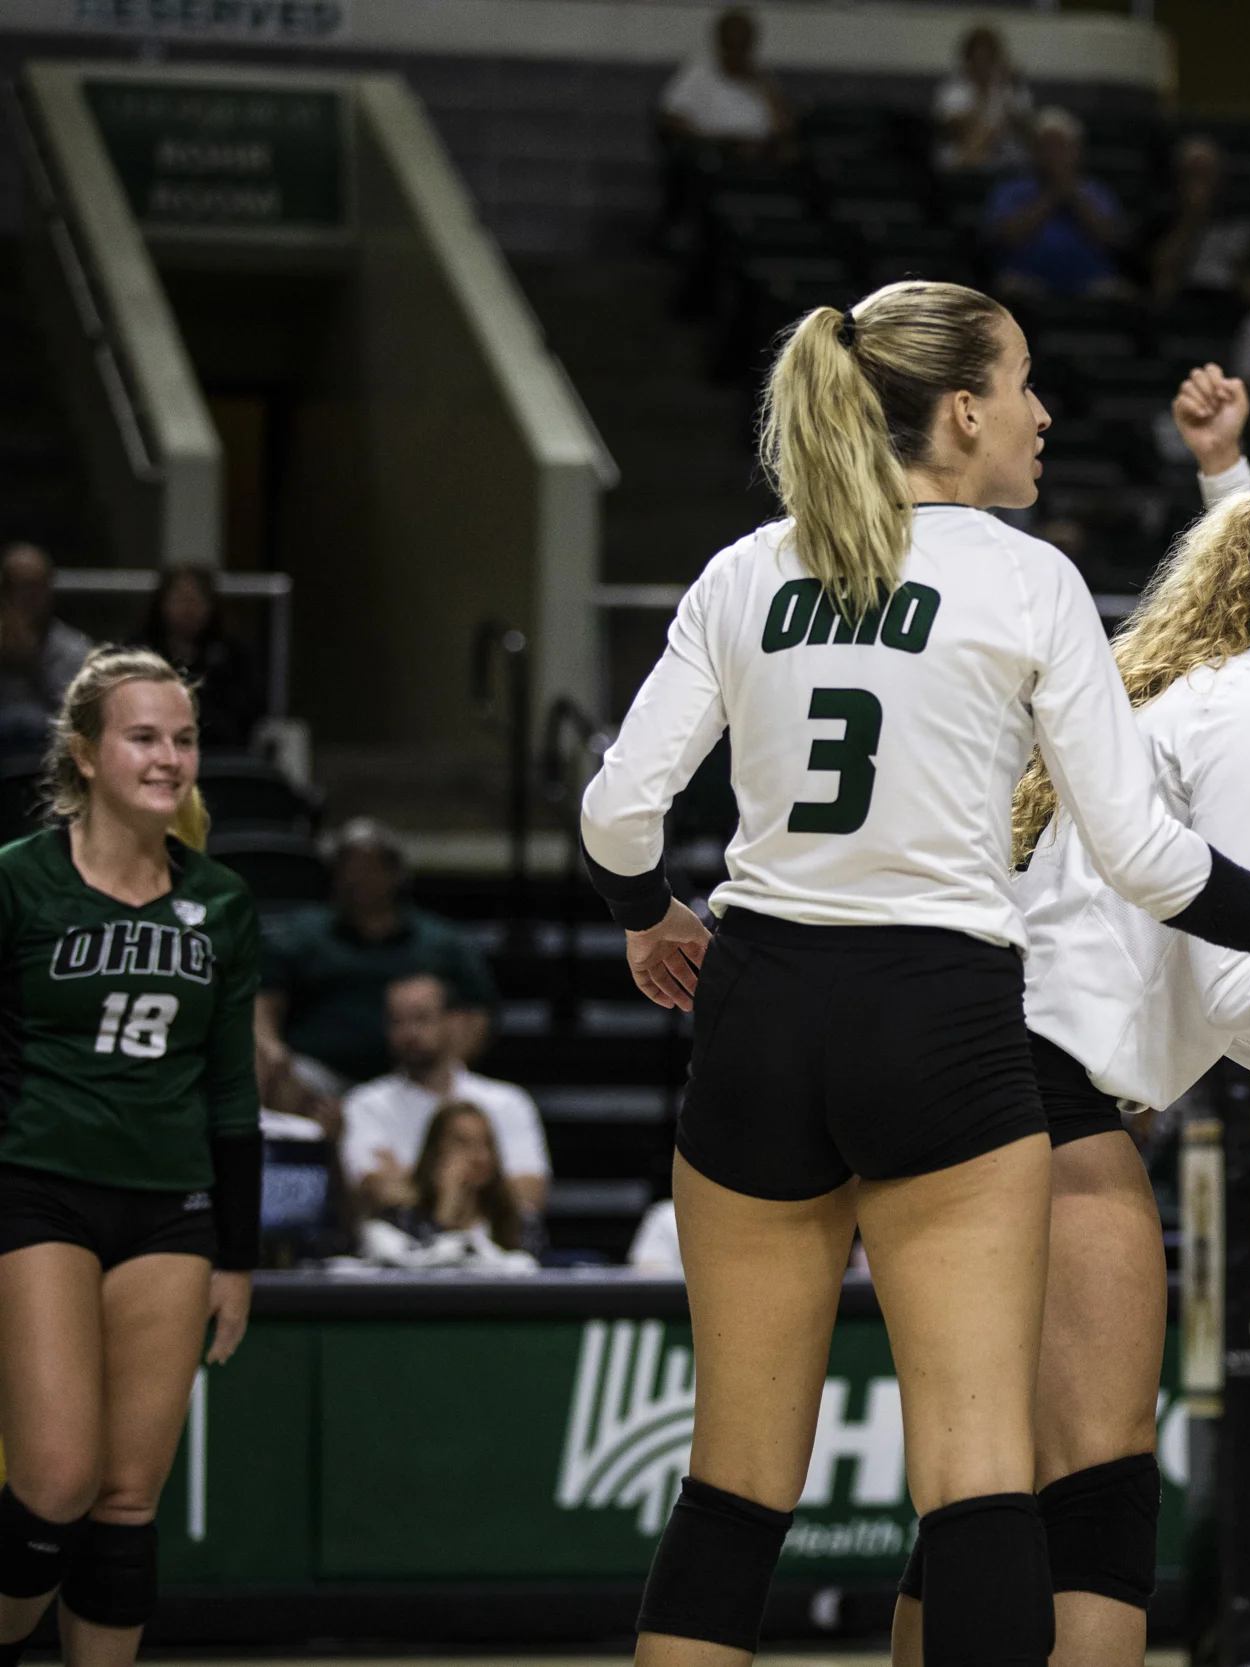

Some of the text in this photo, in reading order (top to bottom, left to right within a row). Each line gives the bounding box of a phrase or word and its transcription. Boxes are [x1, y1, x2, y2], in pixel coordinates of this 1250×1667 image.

[787, 687, 883, 835] 3
[49, 919, 214, 986] OHIO
[94, 991, 180, 1060] 18
